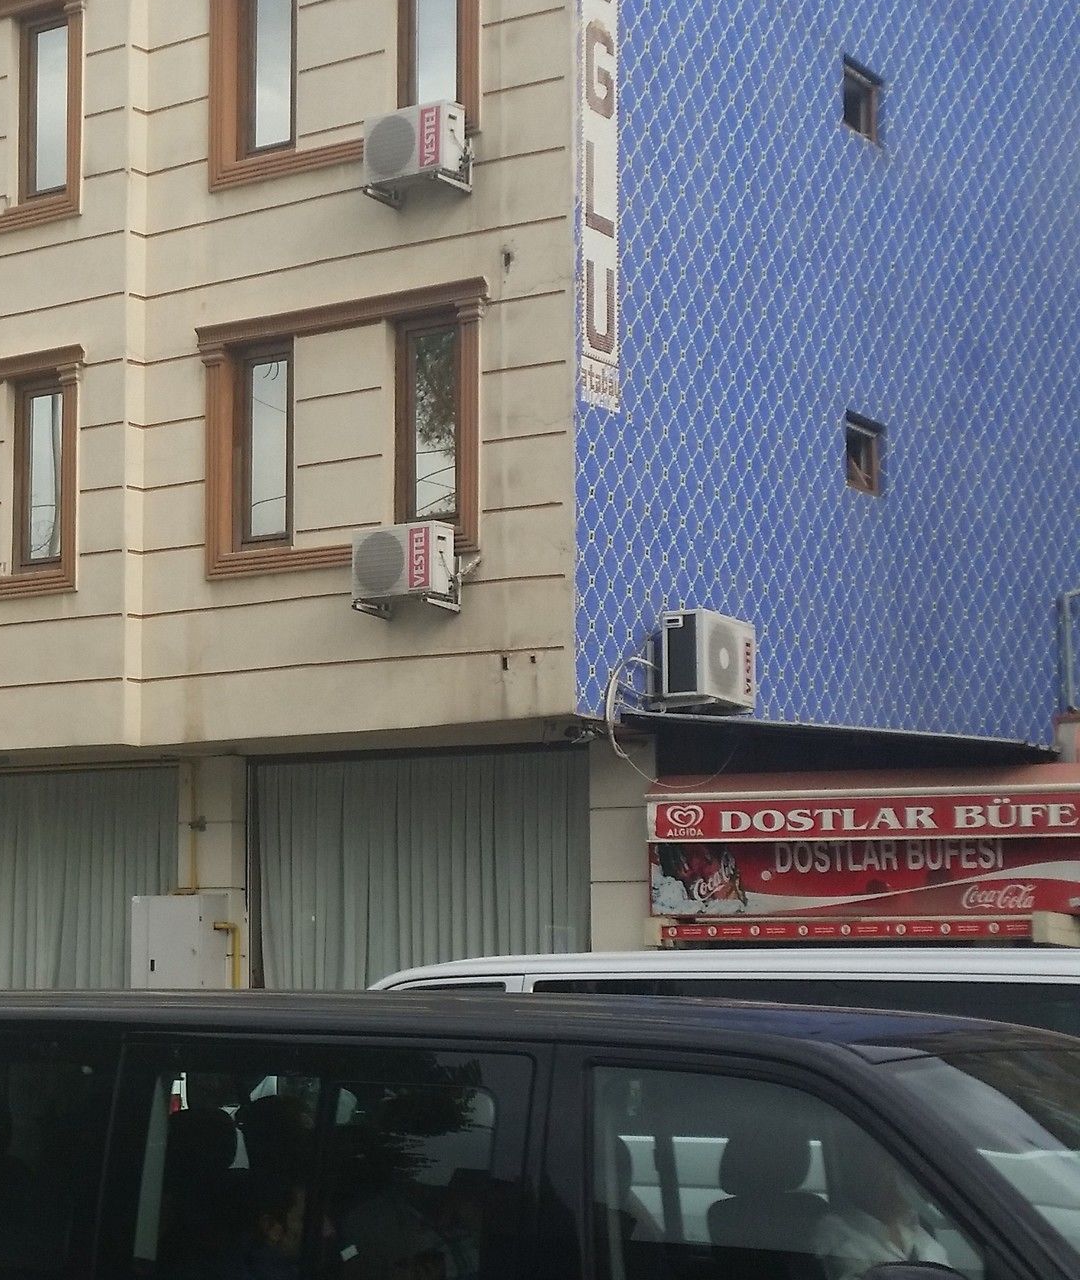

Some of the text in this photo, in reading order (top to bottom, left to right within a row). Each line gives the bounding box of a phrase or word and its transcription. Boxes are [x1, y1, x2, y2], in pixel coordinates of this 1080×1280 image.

[421, 107, 437, 166] VESTEL
[411, 528, 427, 586] VESTEL
[720, 798, 1079, 833] DOSTLAR BÜFE
[774, 839, 898, 874] DOSTLAR
